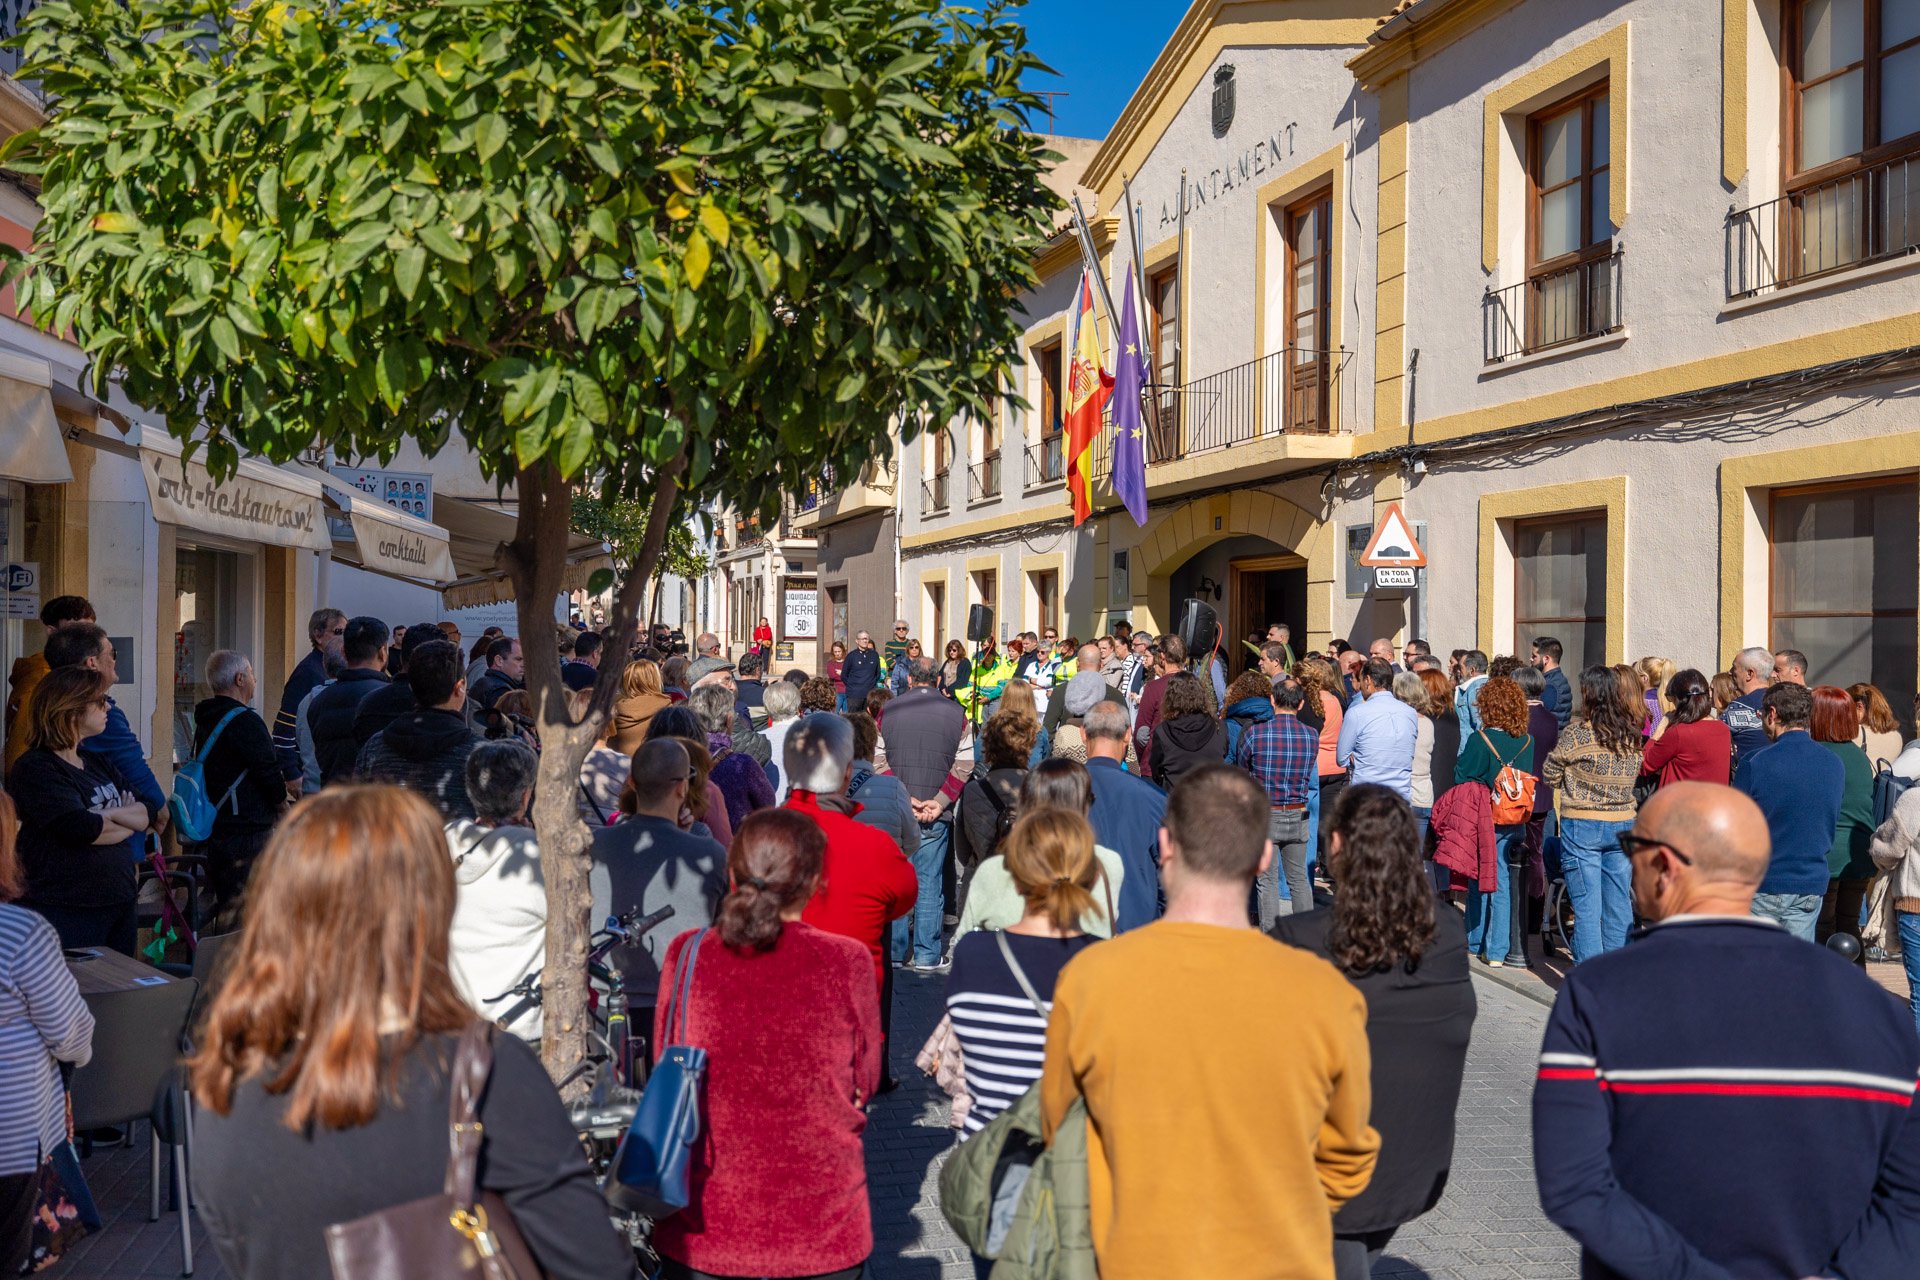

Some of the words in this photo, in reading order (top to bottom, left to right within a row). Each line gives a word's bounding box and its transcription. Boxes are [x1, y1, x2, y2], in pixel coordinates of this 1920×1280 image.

[1160, 121, 1298, 230] AJUNTAMENT
[379, 534, 427, 566] cocktails
[785, 592, 818, 601] LIQUIDACIÓ
